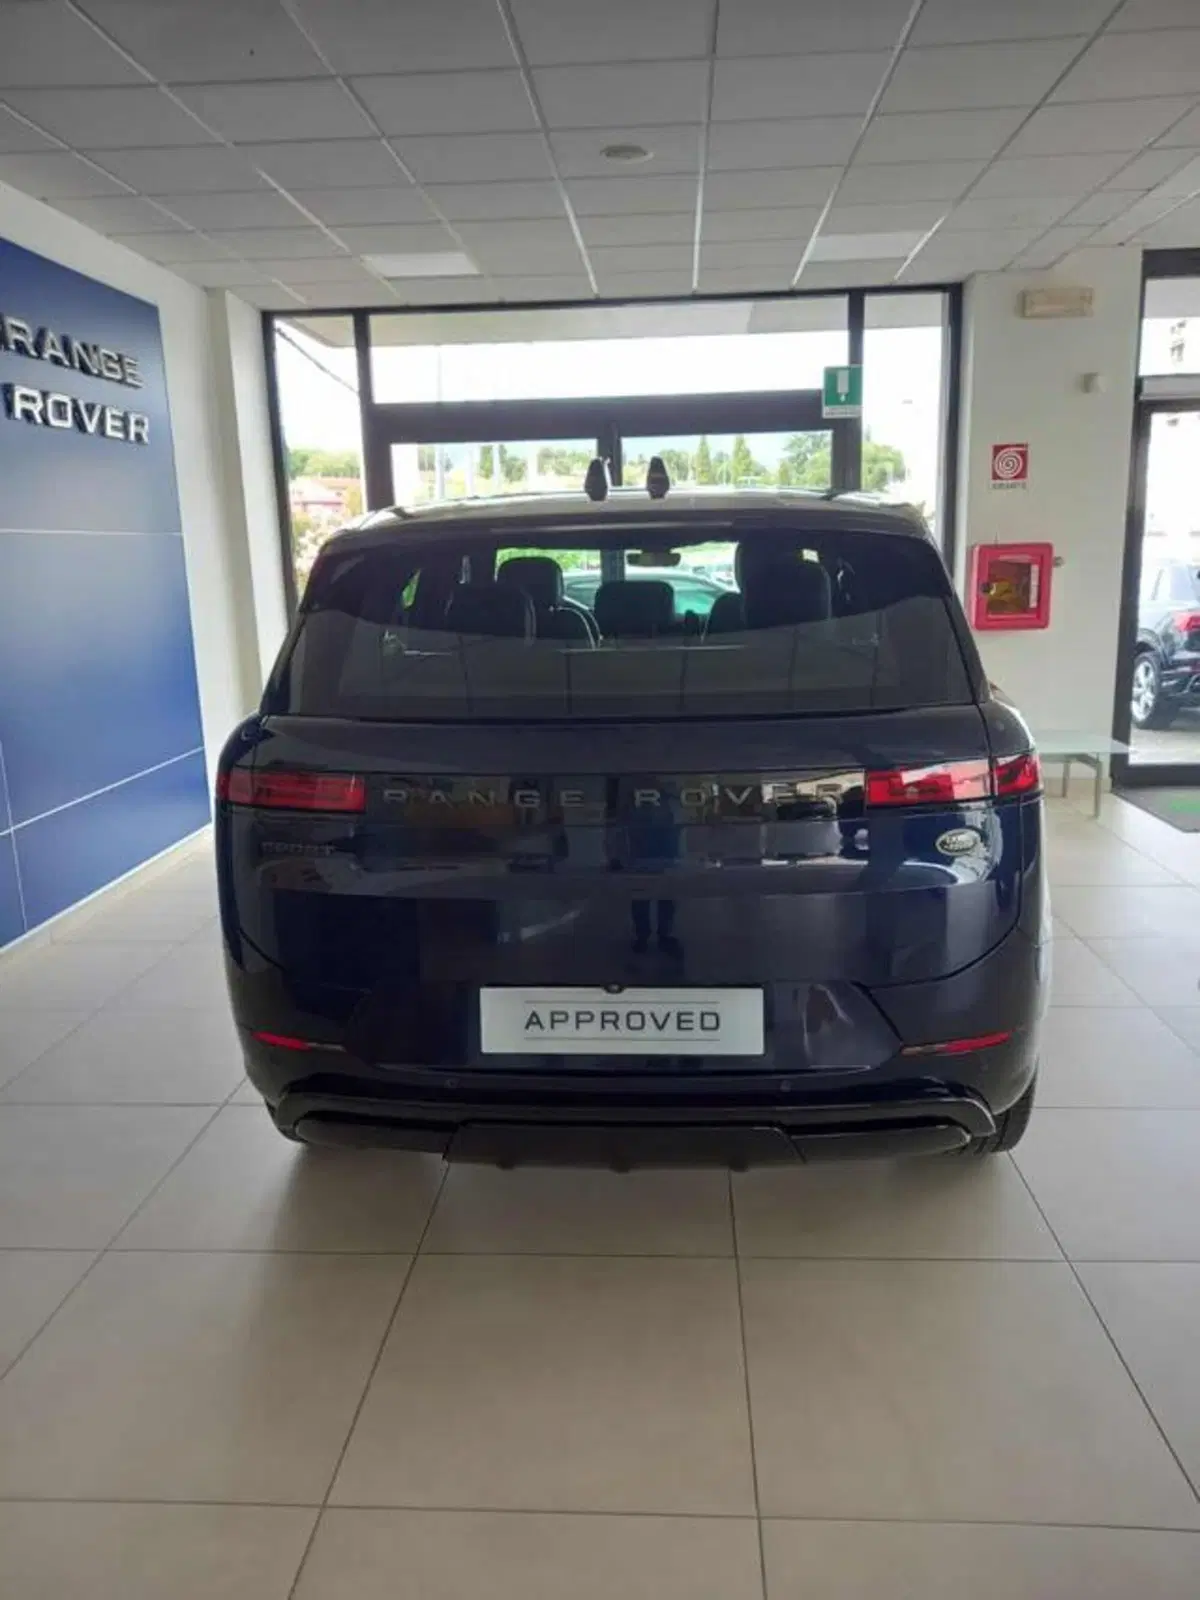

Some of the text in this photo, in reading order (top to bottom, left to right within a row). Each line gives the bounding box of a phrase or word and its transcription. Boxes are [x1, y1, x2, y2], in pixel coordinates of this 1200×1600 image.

[3, 316, 143, 388] RANGE
[13, 385, 149, 444] ROVER
[383, 783, 843, 808] RANGE ROVER
[524, 1010, 720, 1031] APPROVED
